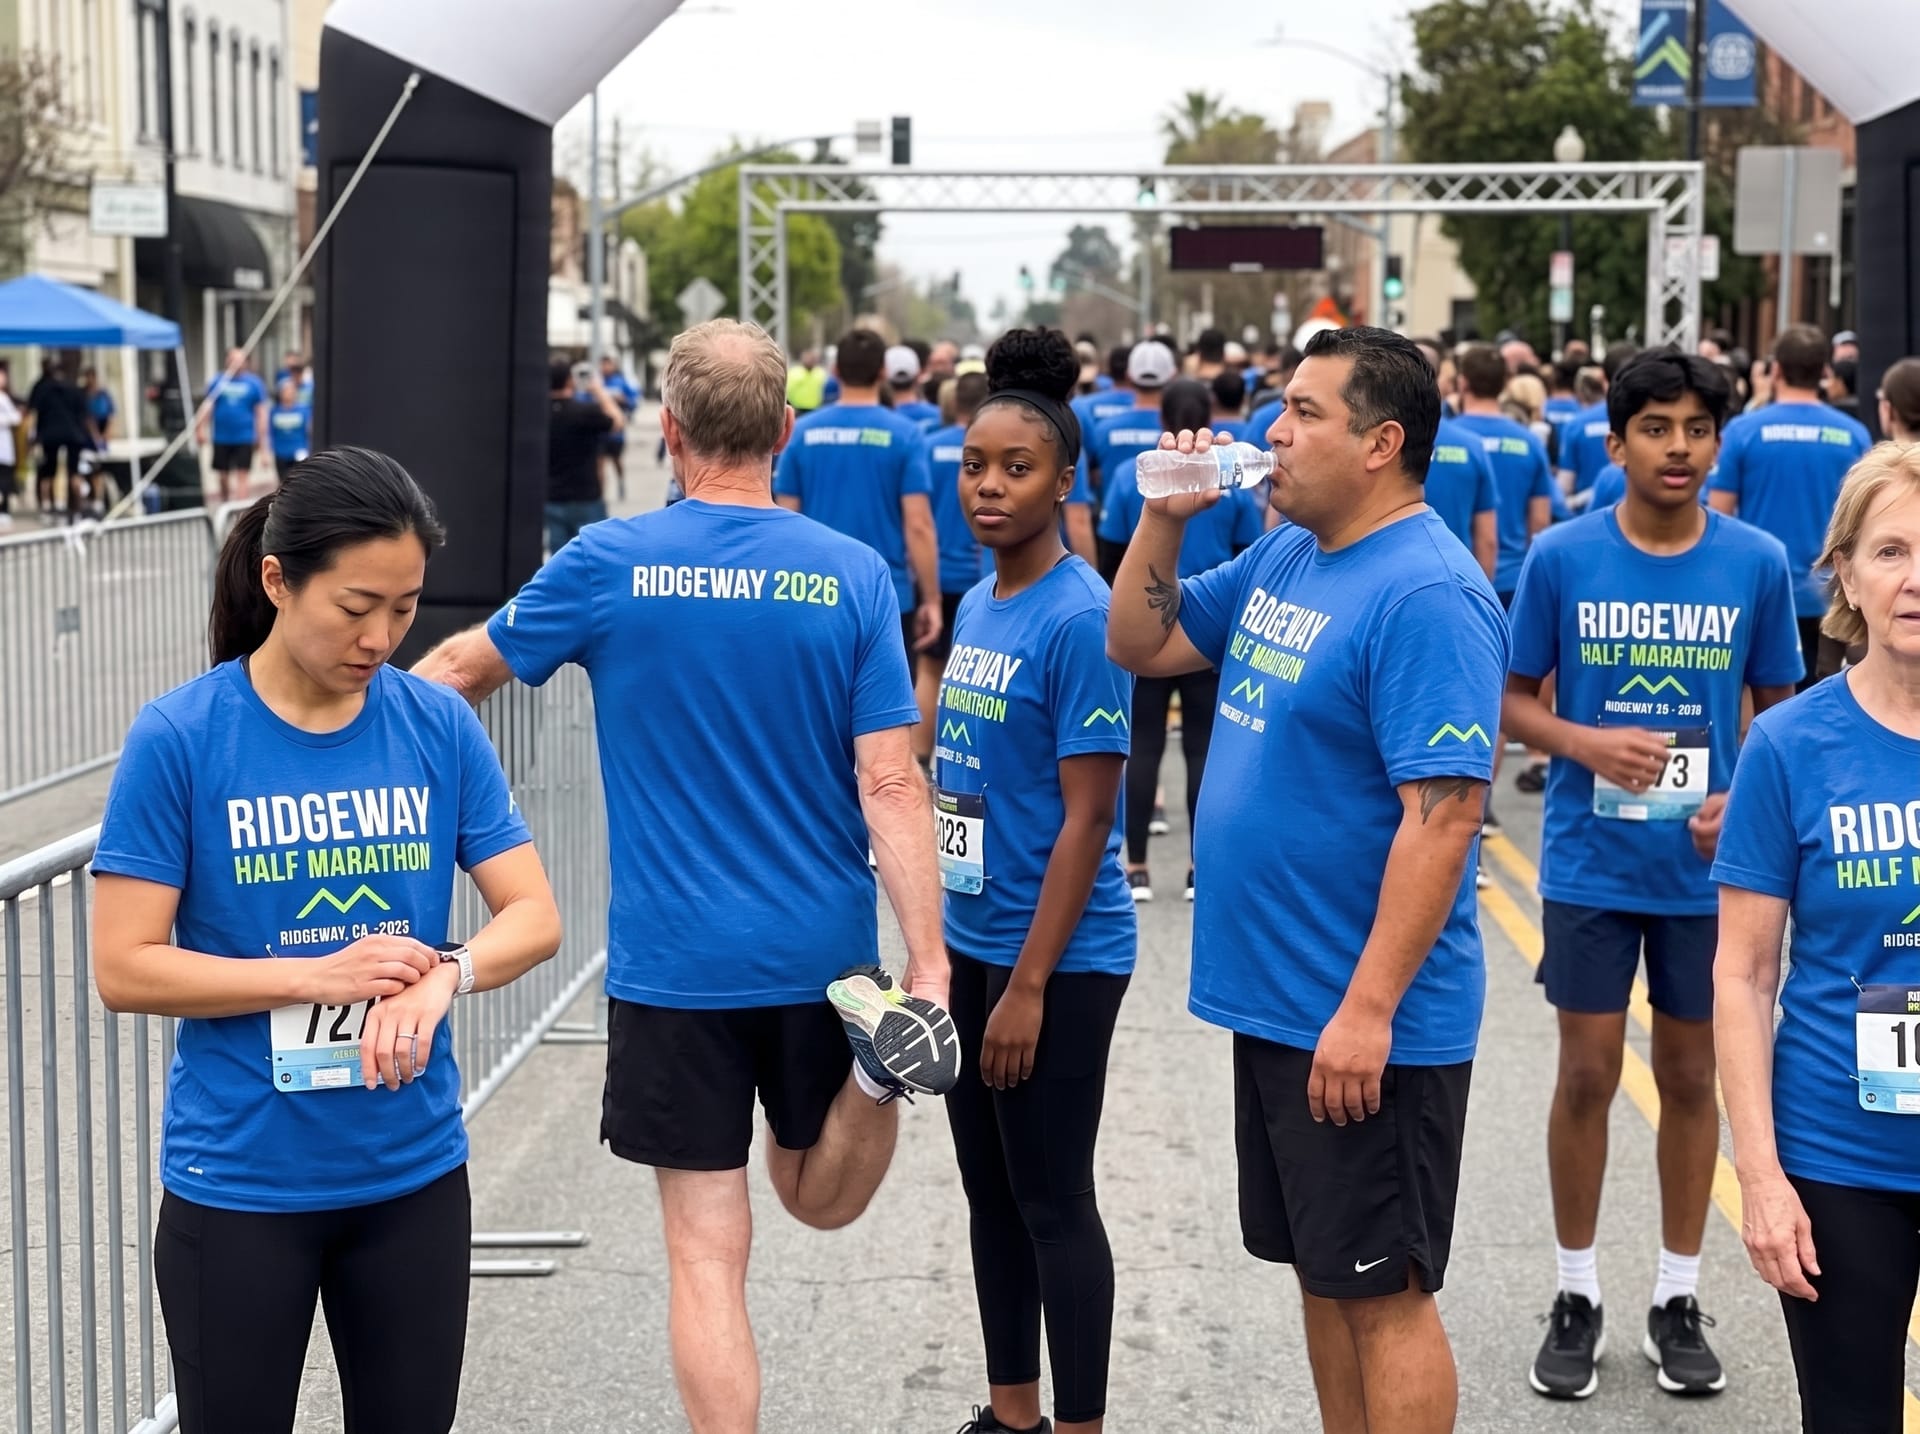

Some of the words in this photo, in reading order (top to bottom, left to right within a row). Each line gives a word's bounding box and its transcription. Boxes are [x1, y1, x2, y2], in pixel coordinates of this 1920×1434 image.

[632, 565, 767, 600] RIDGEWAY
[773, 570, 839, 607] 2026
[1577, 601, 1741, 644] RIDGEWAY
[1580, 643, 1625, 666] HALF
[1629, 644, 1732, 671] MARATHON
[945, 686, 1008, 723] MARATHON
[1605, 700, 1653, 715] RIDGEWAY
[227, 786, 430, 849] RIDGEWAY
[233, 851, 299, 884] HALF
[306, 842, 431, 879] MARATHON
[1836, 857, 1903, 889] HALF
[280, 926, 349, 946] RIDGEWAY,
